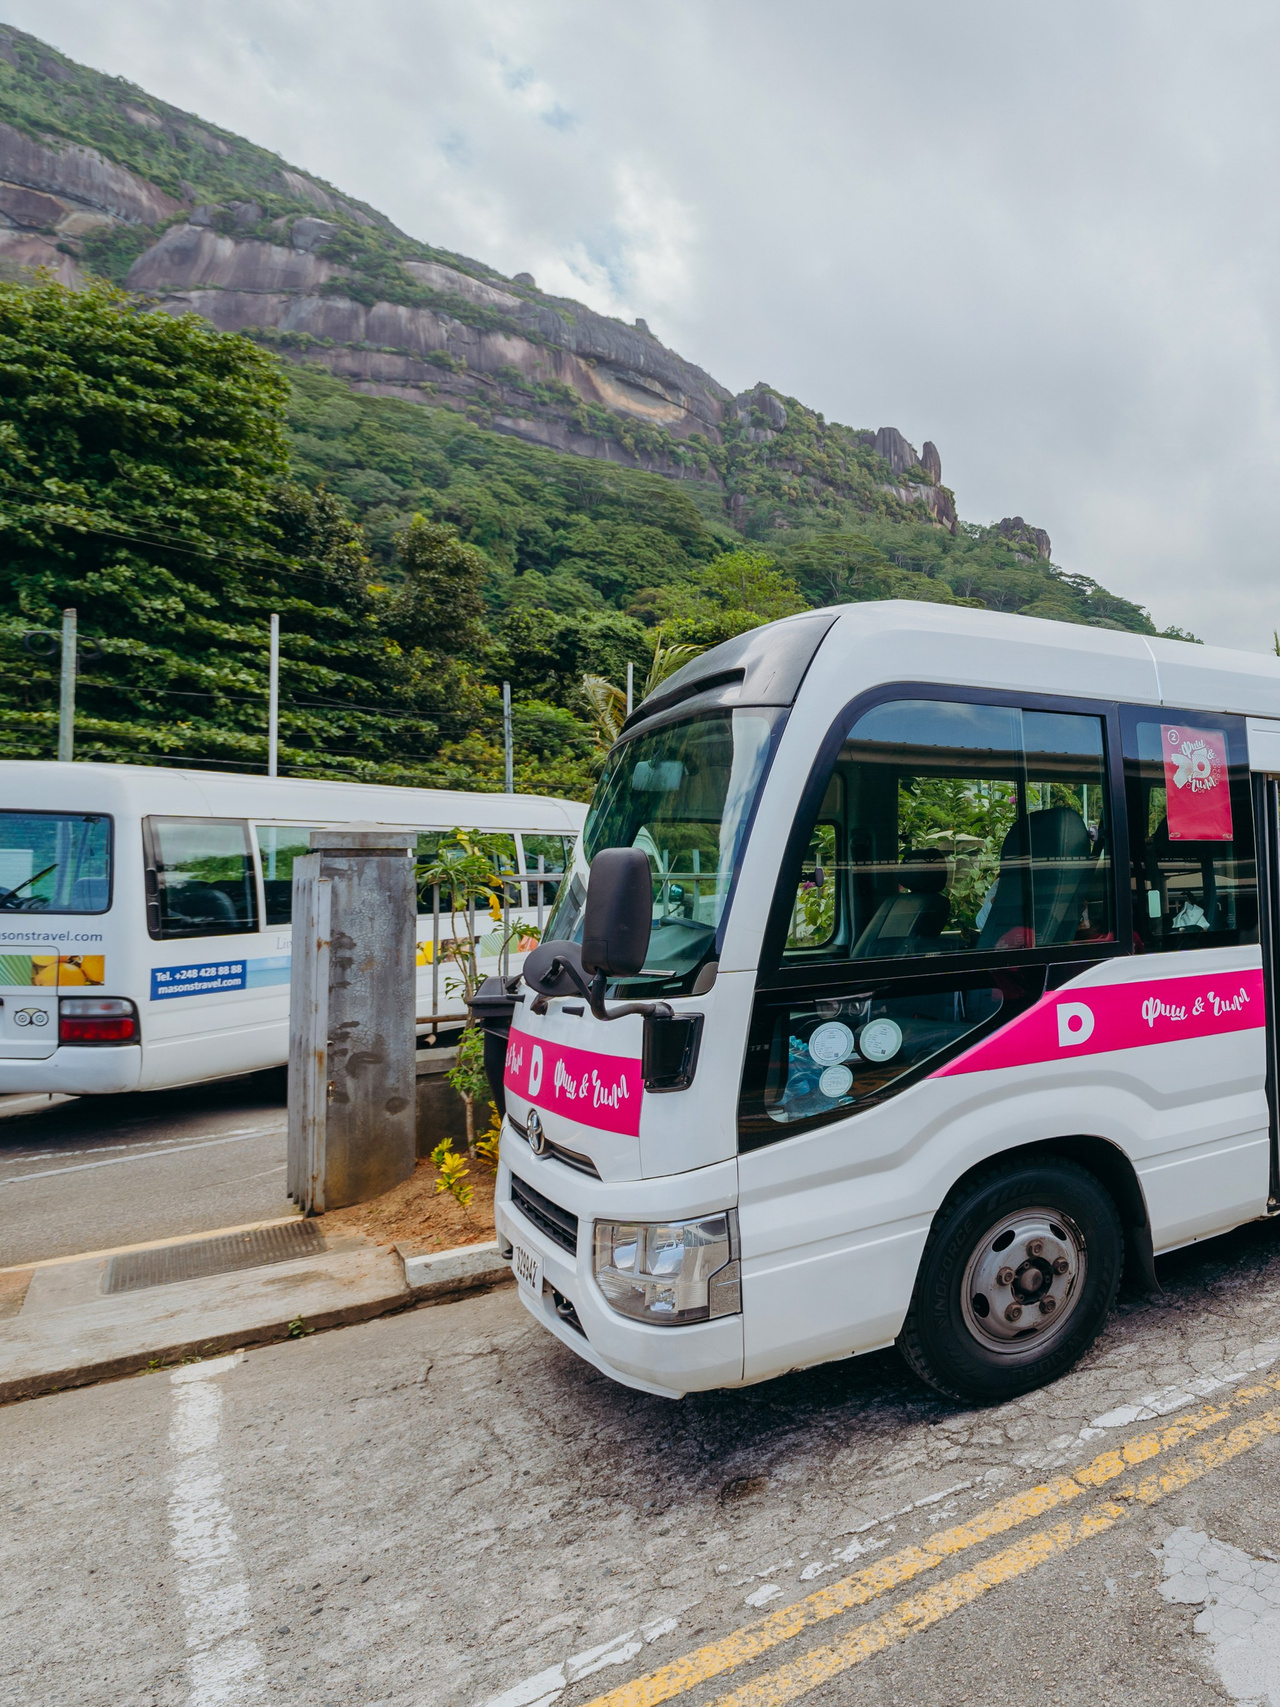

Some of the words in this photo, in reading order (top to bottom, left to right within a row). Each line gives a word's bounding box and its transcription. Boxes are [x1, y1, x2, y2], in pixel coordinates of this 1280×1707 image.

[0, 931, 103, 942] sonstravel.com
[155, 971, 173, 982] Tel.
[174, 969, 198, 980] +248
[200, 967, 216, 977] 428
[218, 966, 229, 975] 88
[231, 964, 242, 974] 88
[158, 978, 242, 994] masonstravel.com
[1056, 1001, 1095, 1047] D
[1192, 996, 1205, 1016] &
[579, 1073, 589, 1099] &
